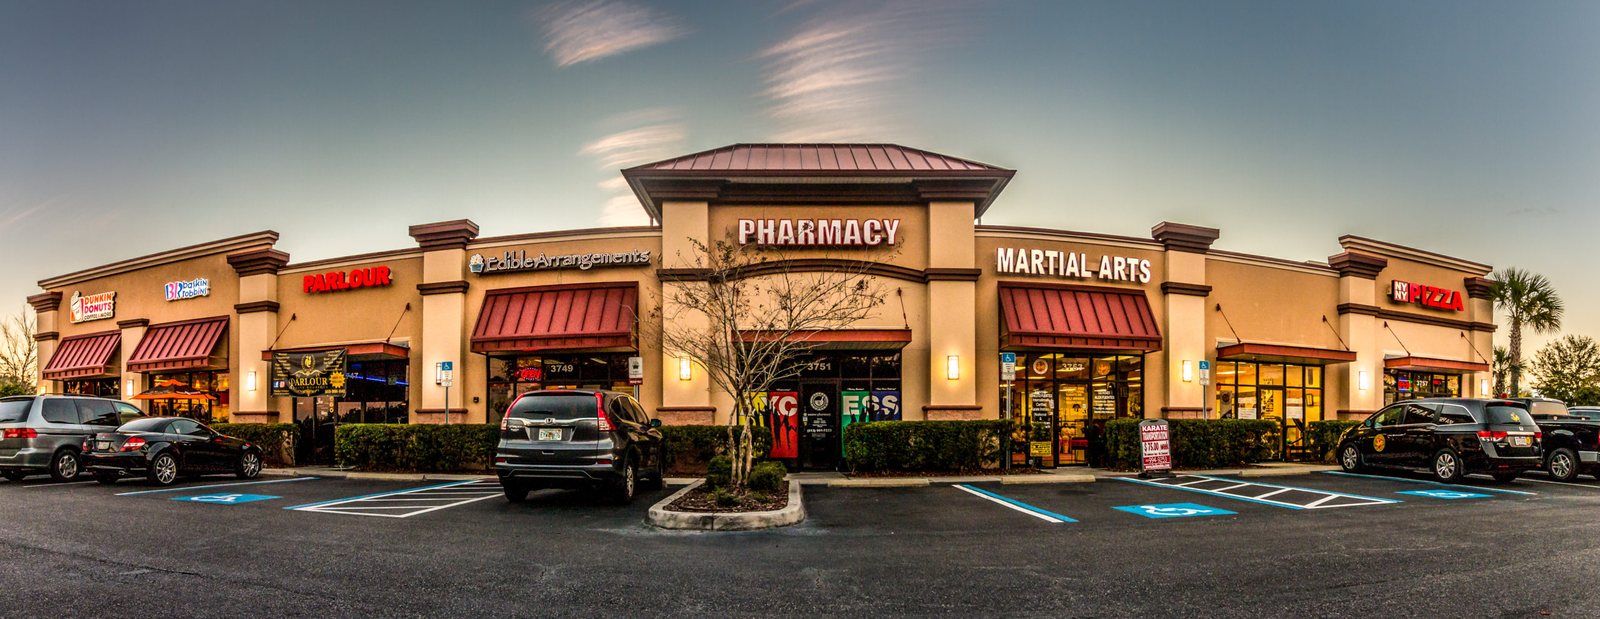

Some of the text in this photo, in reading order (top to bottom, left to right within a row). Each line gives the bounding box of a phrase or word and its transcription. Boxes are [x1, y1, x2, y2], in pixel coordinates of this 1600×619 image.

[738, 219, 900, 246] PHARMACY
[486, 249, 651, 271] Edible Arrangements
[996, 247, 1151, 284] MARTIAL ARTS
[303, 265, 391, 293] PARLOUR
[1394, 281, 1408, 291] NY
[1394, 290, 1408, 300] NY
[1409, 282, 1464, 311] PIZZA
[84, 302, 112, 314] DONUTS
[550, 364, 574, 373] 3749
[807, 362, 832, 371] 3751
[289, 376, 328, 388] PARLOUR
[1142, 424, 1168, 432] KARATE
